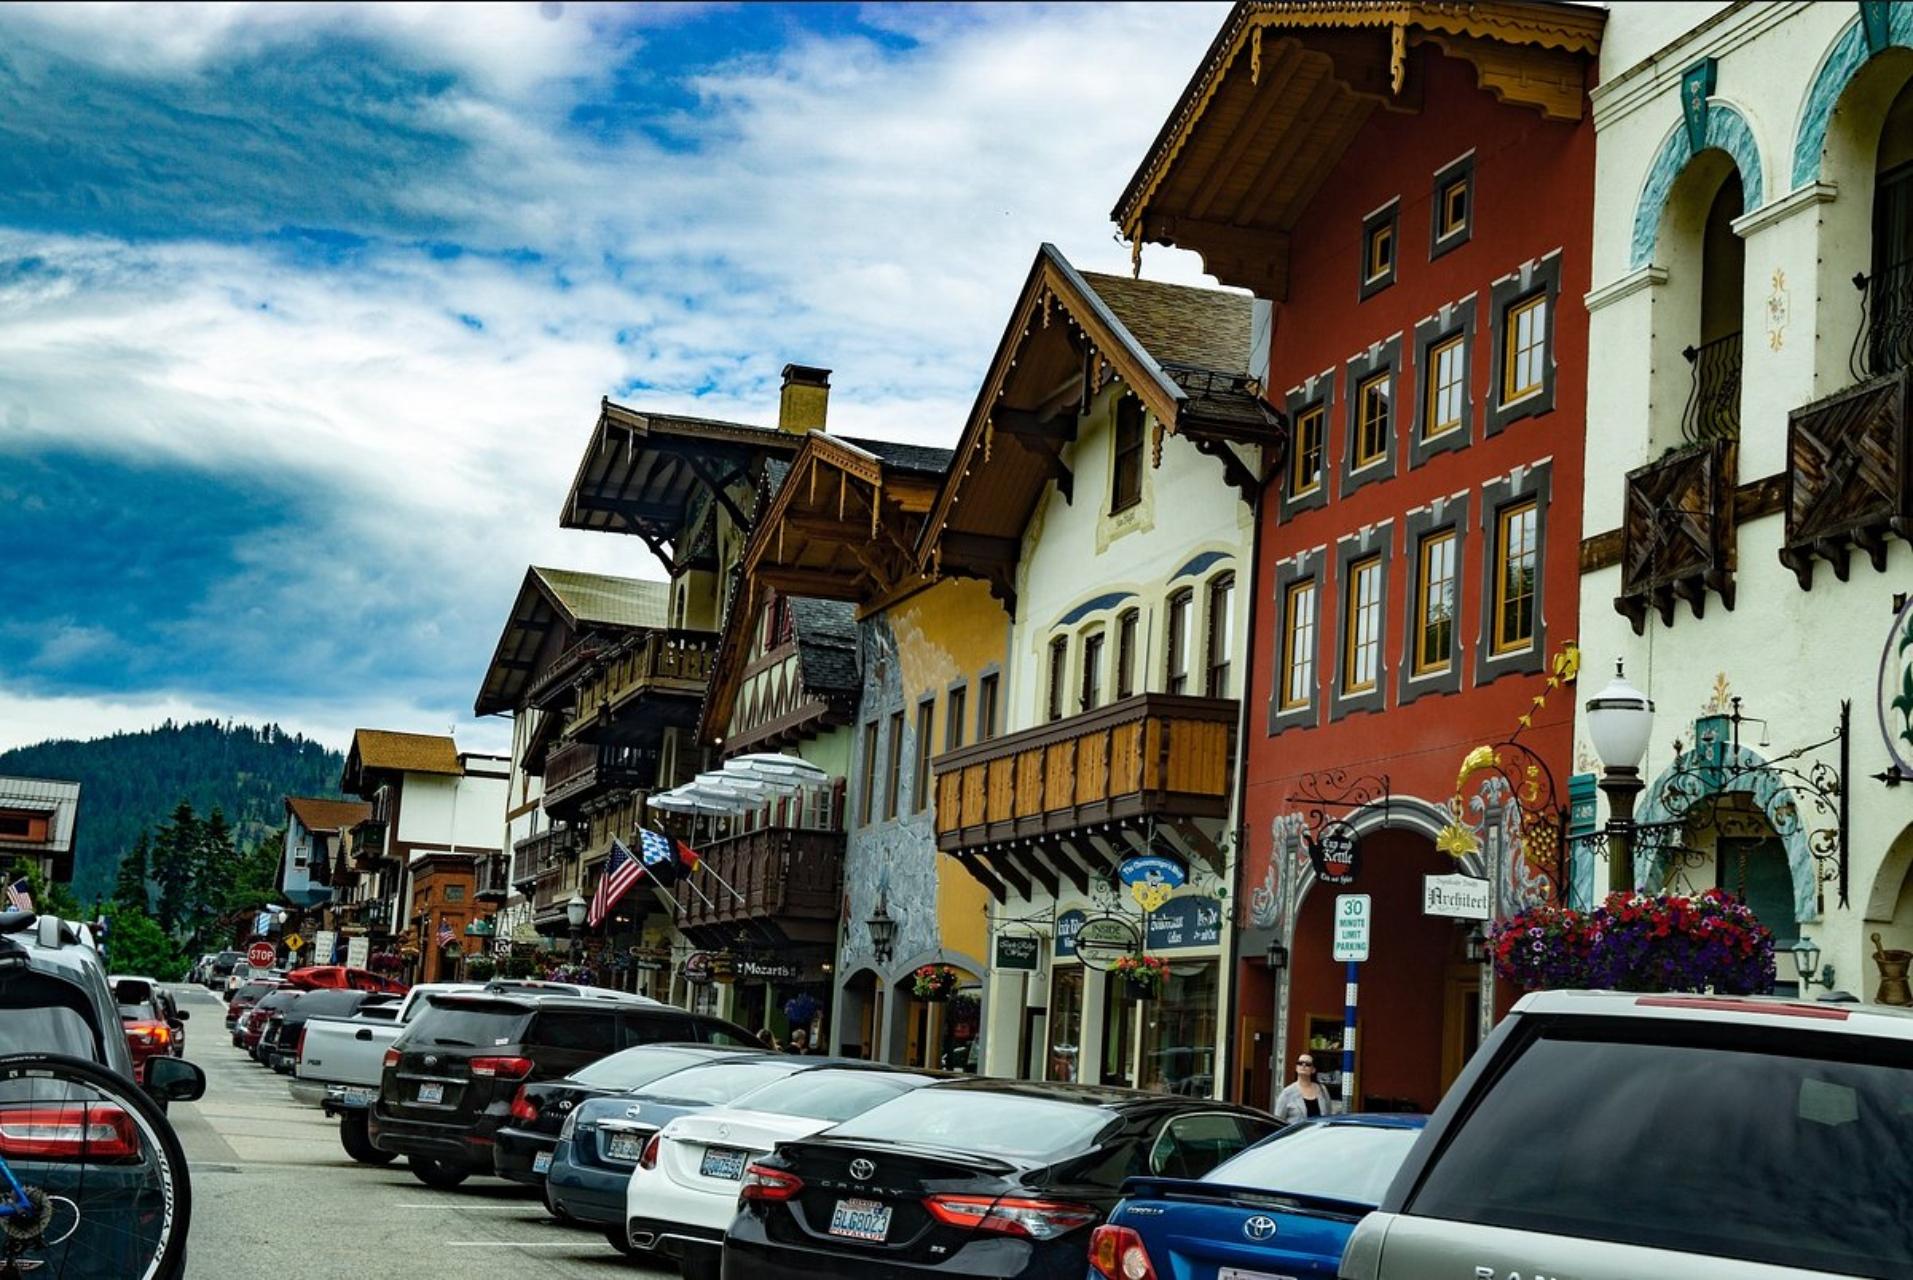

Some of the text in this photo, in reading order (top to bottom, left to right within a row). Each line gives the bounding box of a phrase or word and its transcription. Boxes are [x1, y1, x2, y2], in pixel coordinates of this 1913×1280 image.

[1323, 850, 1353, 864] Kettle
[1428, 886, 1487, 909] Architect
[1344, 900, 1363, 916] 30
[1339, 919, 1365, 928] MINUTE
[1342, 930, 1361, 940] LIMIT
[1336, 941, 1366, 951] PARKING
[250, 949, 274, 961] STOP
[744, 961, 790, 977] Mozart's
[820, 1180, 904, 1195] CAMRY
